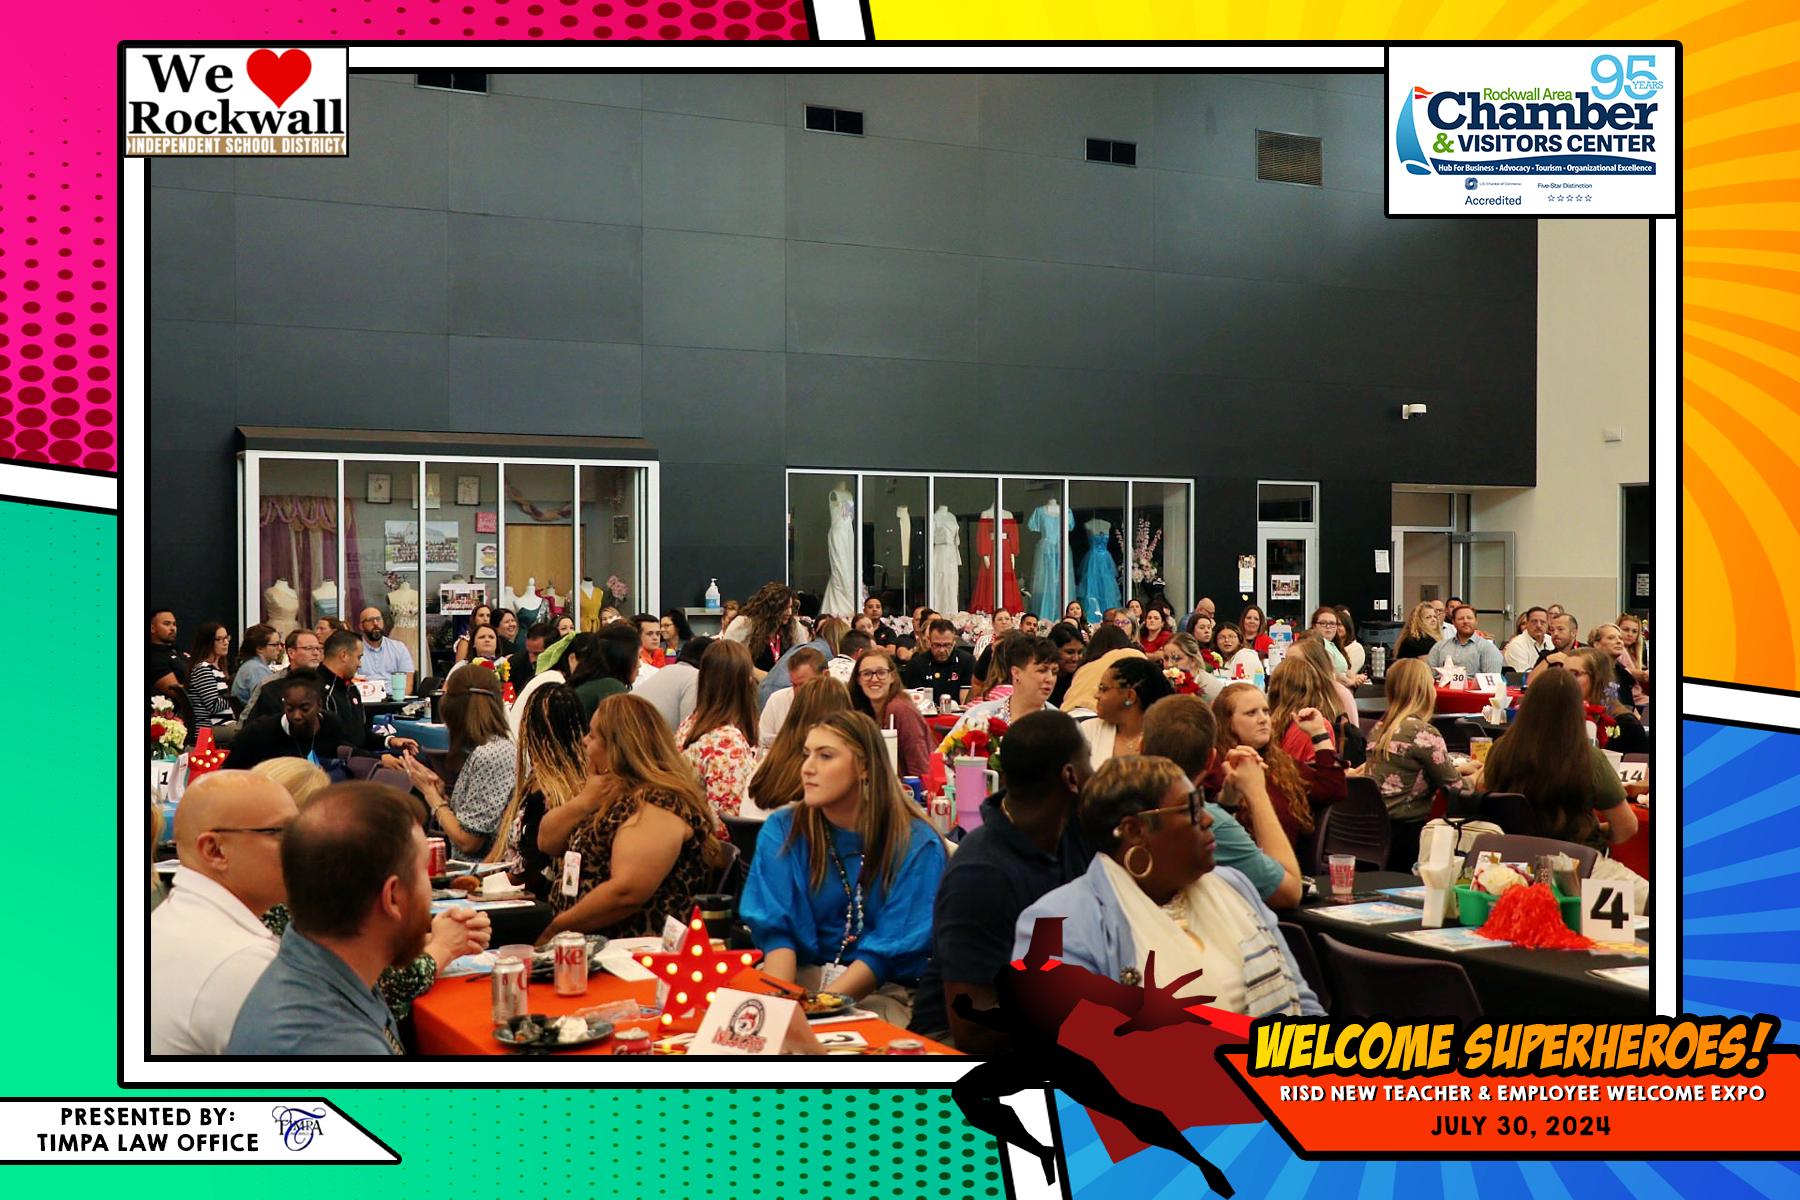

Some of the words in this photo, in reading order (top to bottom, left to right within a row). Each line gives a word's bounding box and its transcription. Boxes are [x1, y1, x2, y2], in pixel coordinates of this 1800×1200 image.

[1453, 674, 1464, 682] 30
[160, 771, 169, 785] 1
[1619, 770, 1643, 782] 14
[1590, 887, 1629, 929] 4
[555, 945, 583, 965] ke
